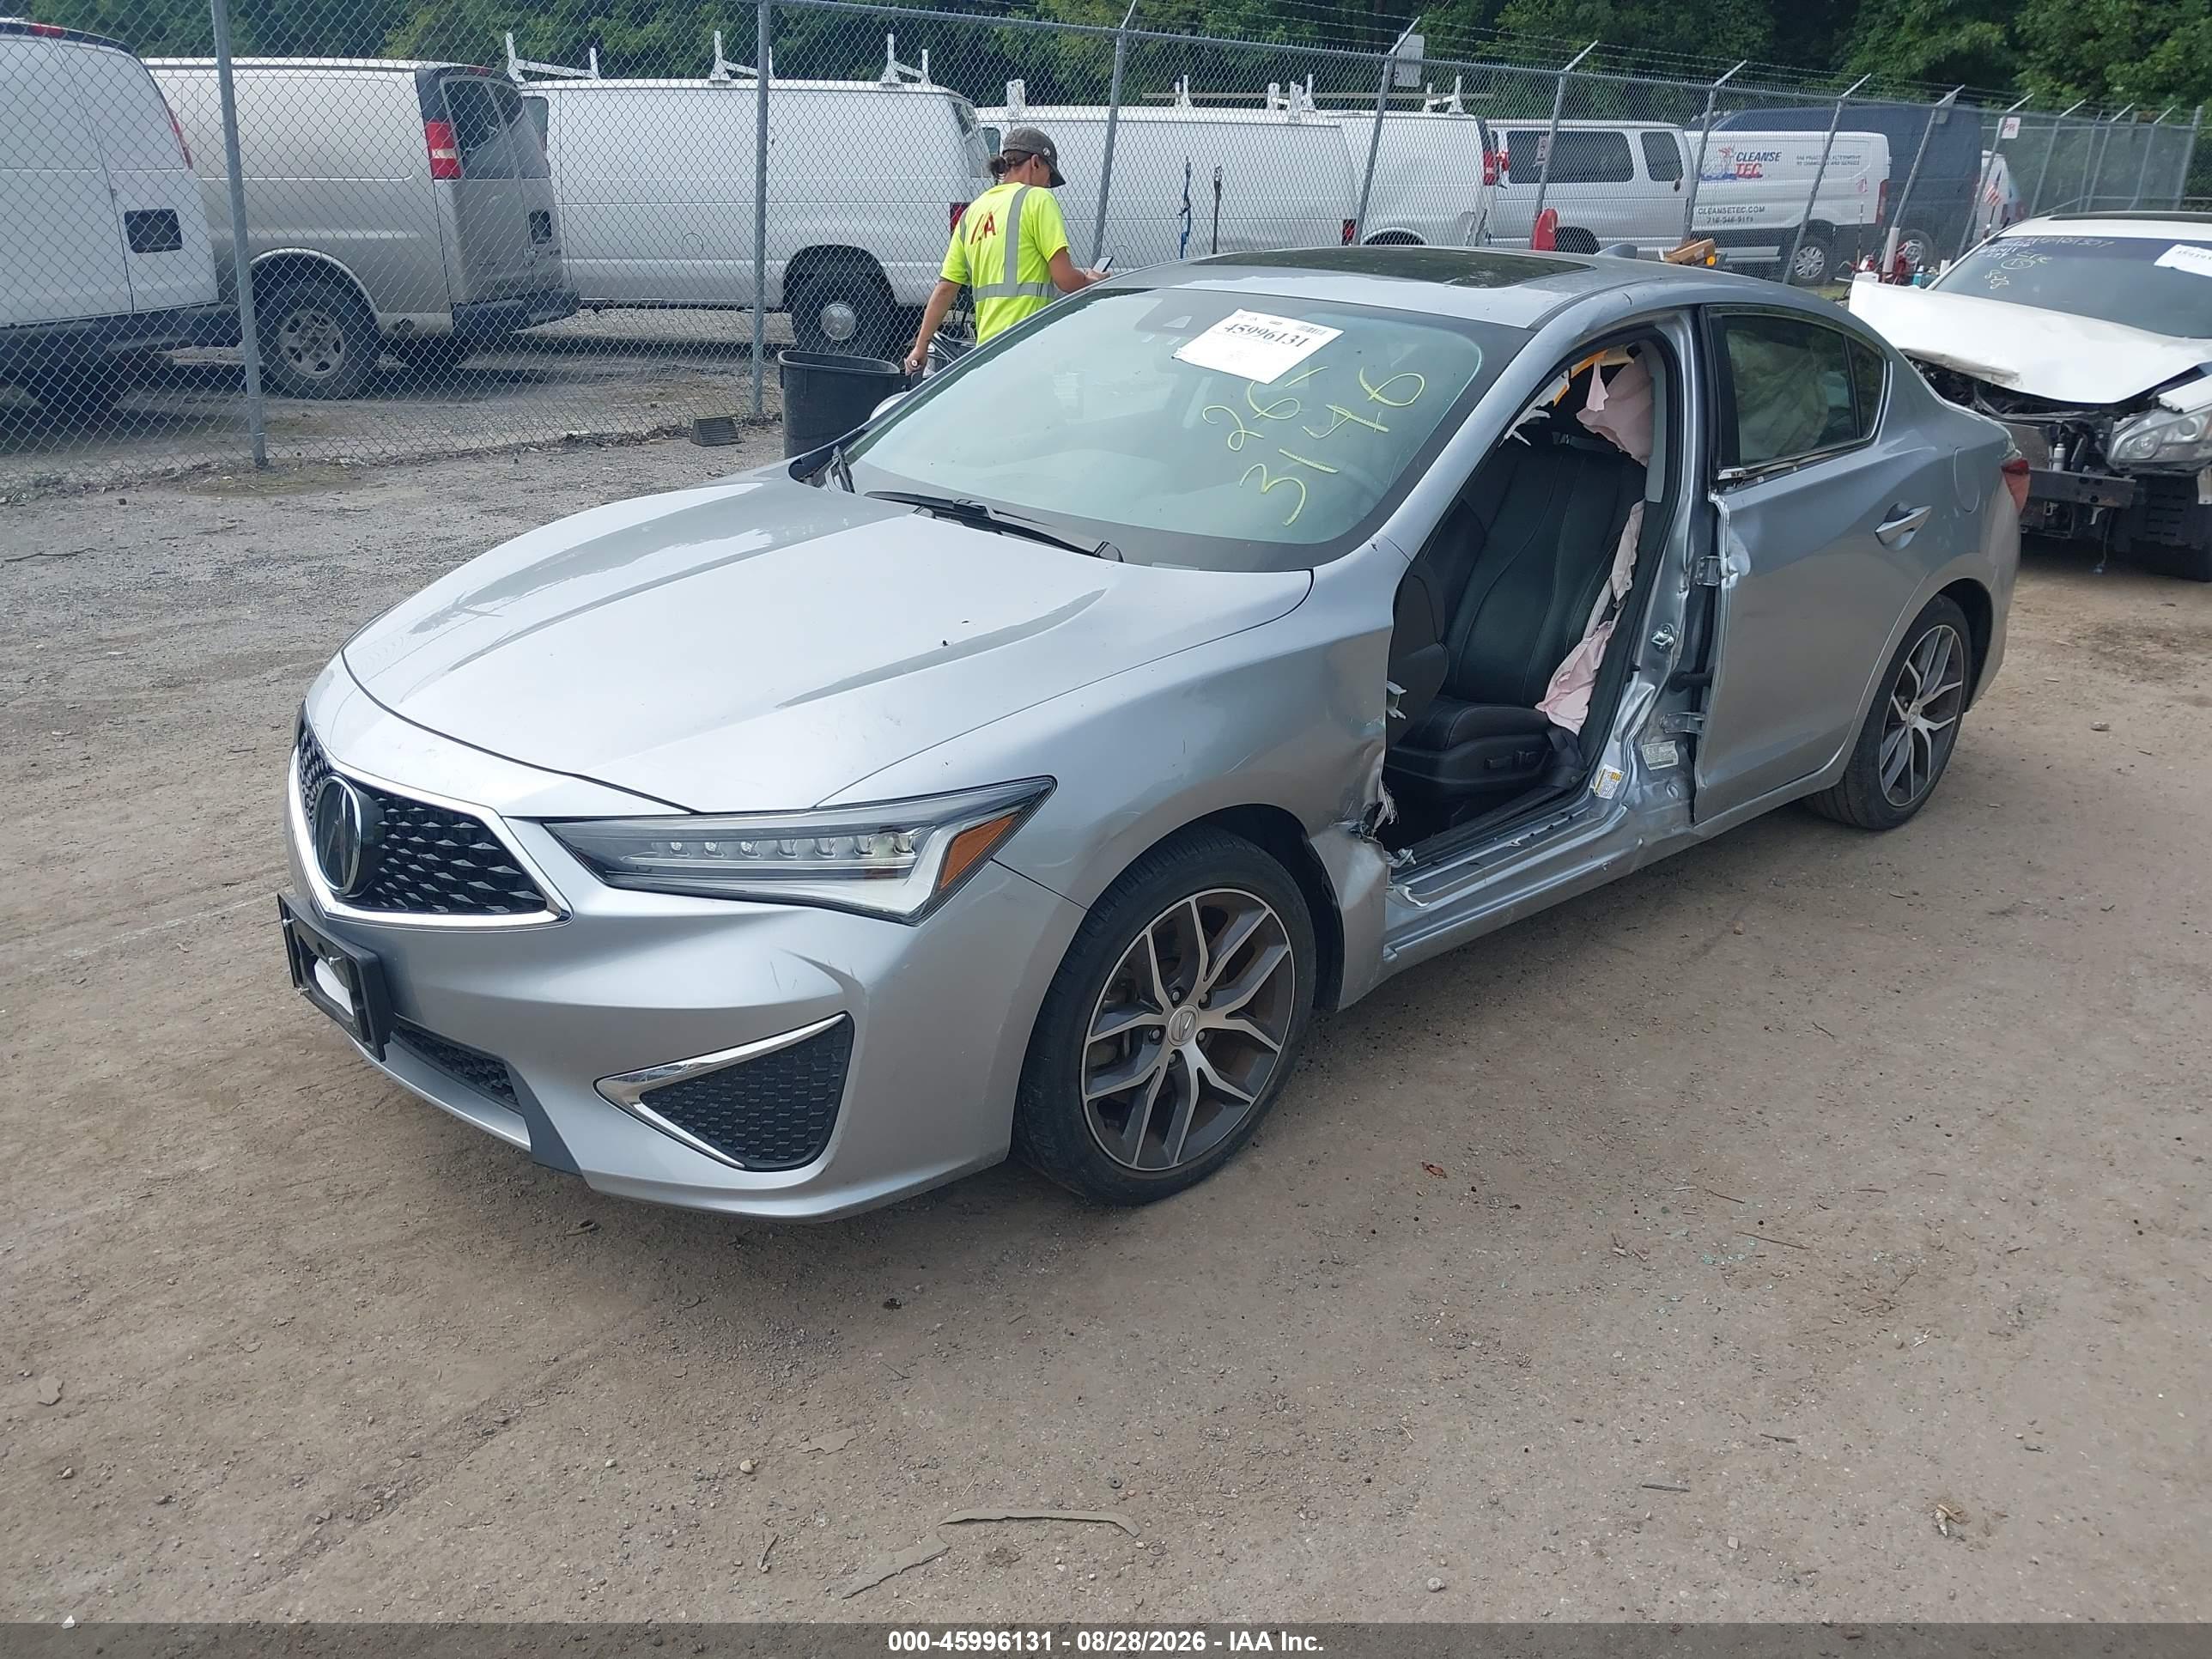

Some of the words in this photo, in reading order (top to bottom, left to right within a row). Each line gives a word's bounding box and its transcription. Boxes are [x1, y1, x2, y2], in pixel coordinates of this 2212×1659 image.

[1736, 151, 1782, 162] CLEANSE
[1735, 163, 1762, 177] TEC
[1698, 206, 1765, 215] CLEANSETEC.COM
[1224, 323, 1311, 348] 45996131
